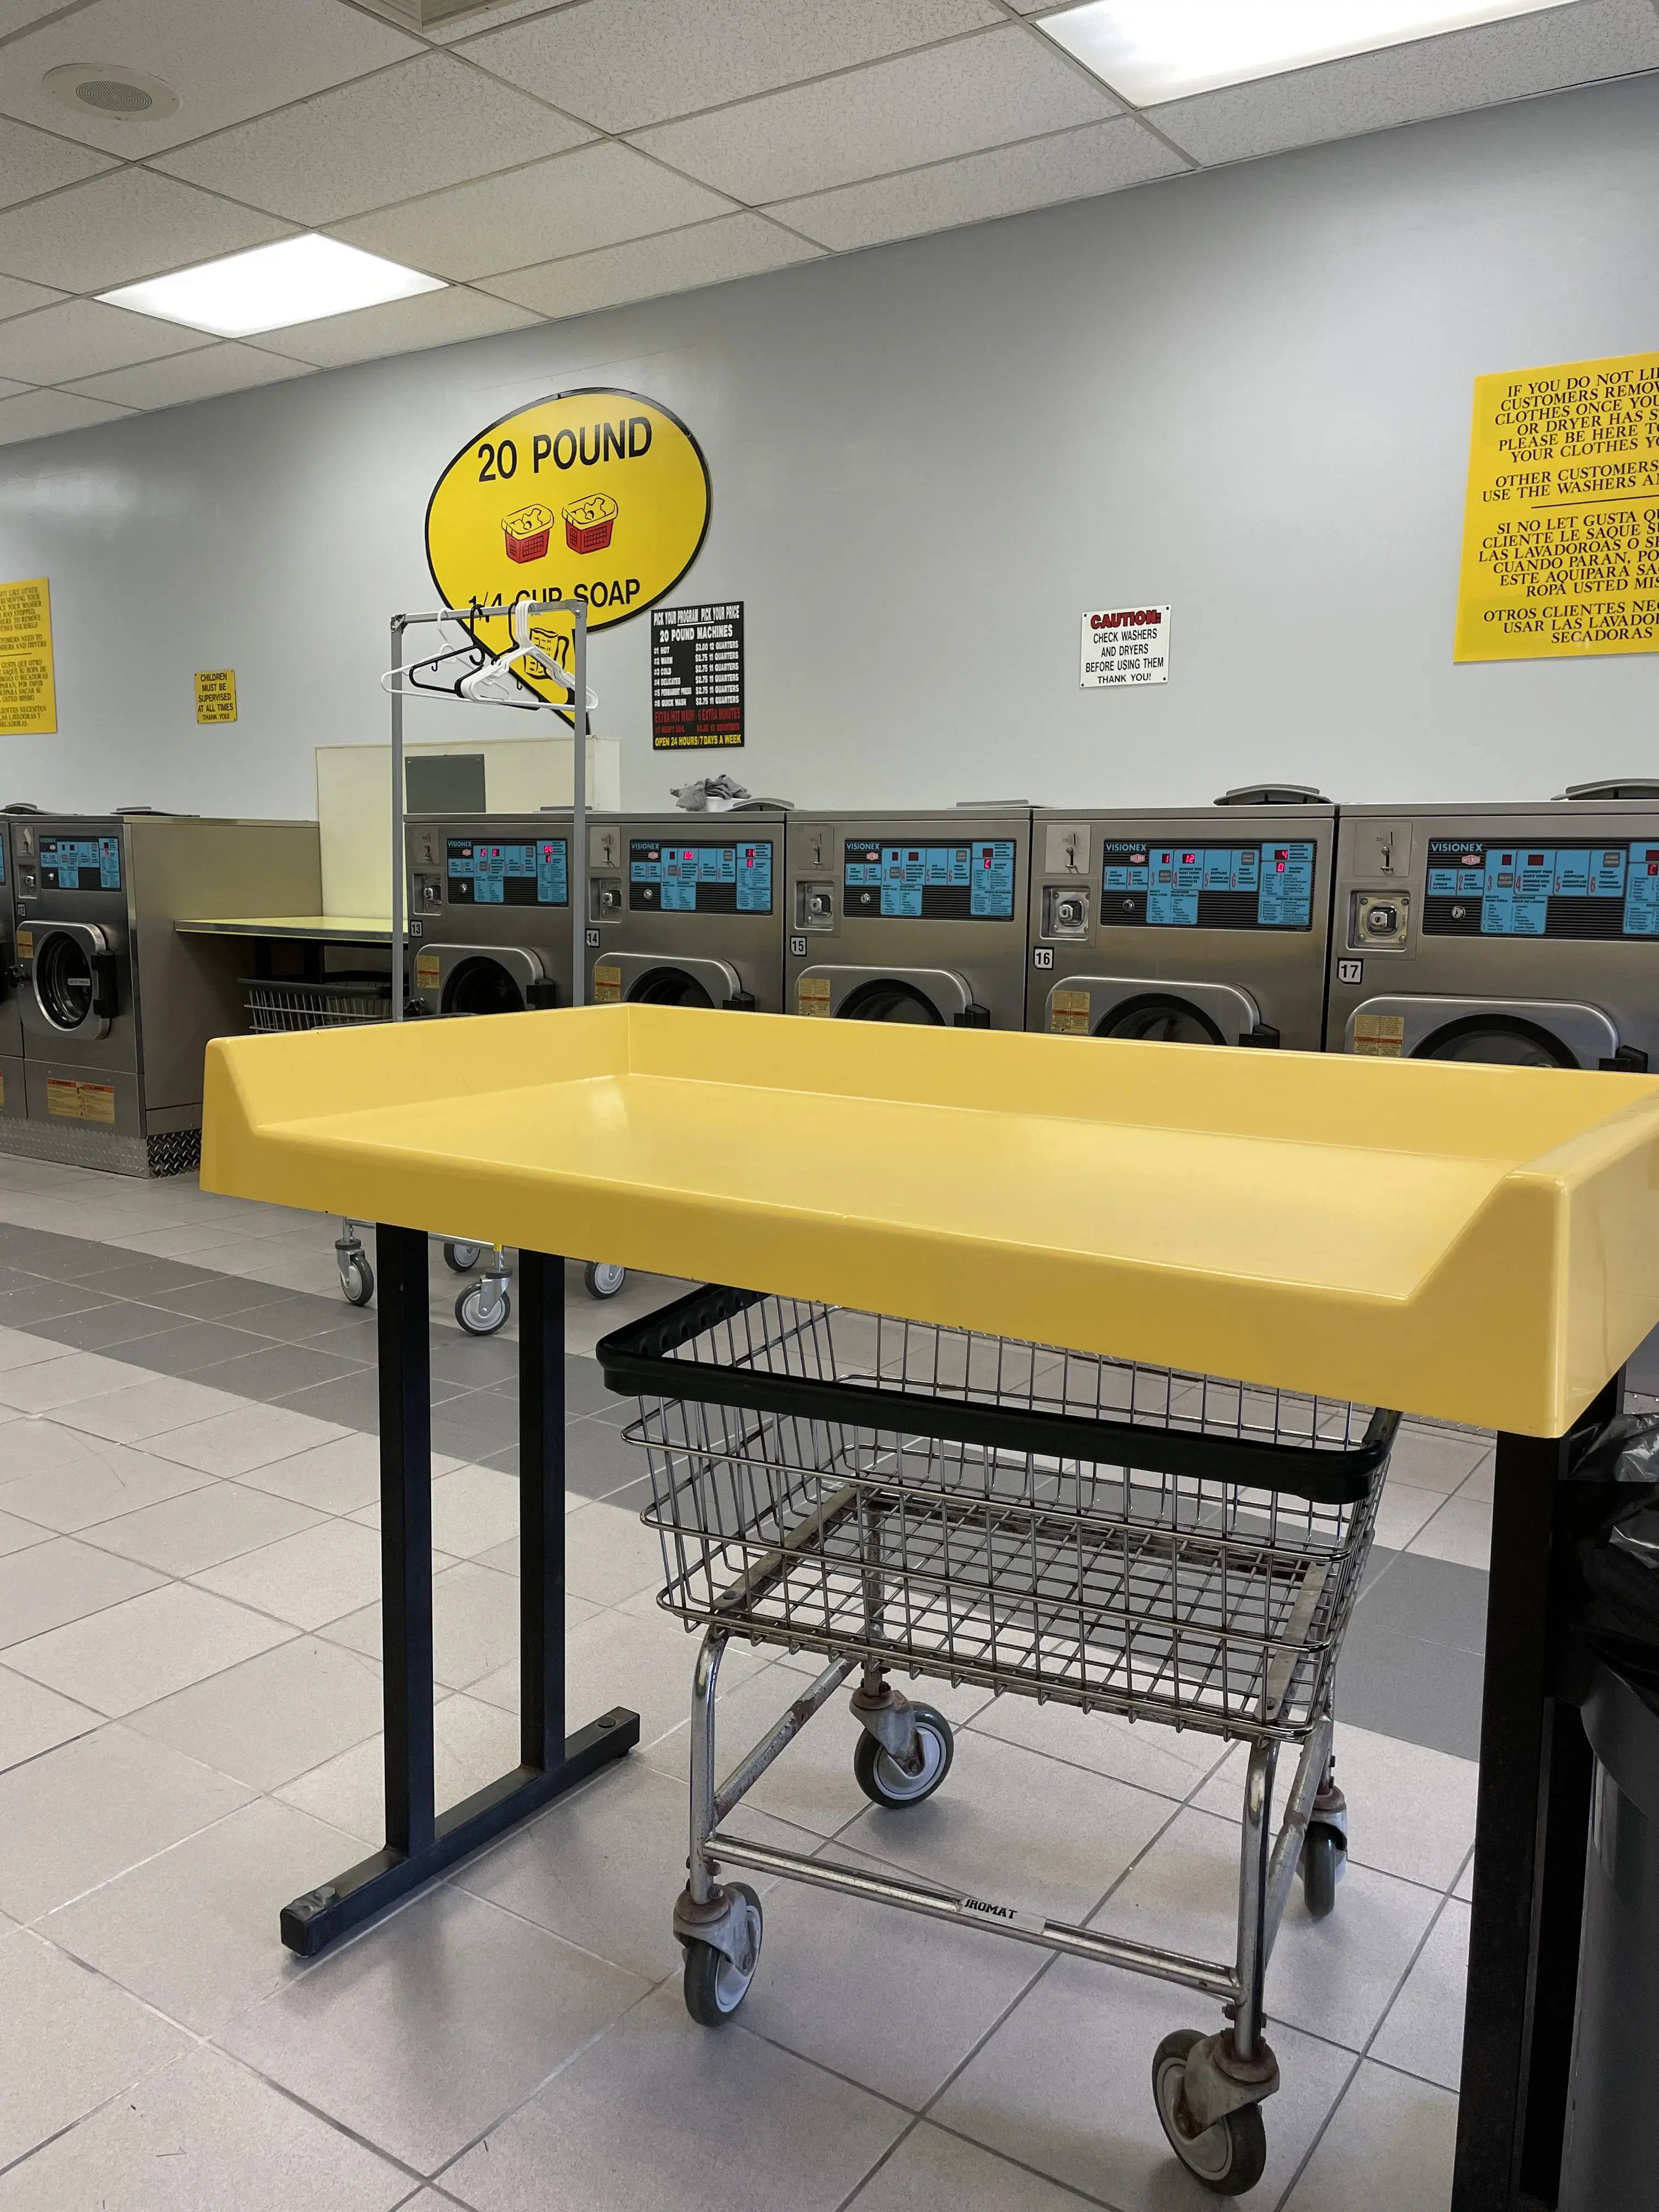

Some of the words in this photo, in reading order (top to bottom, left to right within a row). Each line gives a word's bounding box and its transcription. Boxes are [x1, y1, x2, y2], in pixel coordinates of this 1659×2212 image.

[1508, 385, 1522, 397] IF
[1528, 380, 1560, 394] YOU
[1567, 376, 1590, 390] DO
[1597, 370, 1634, 386] NOT
[1500, 388, 1598, 411] CUSTOMERS
[1495, 405, 1570, 425] CLOTHES
[1576, 399, 1623, 415] ONCE
[1517, 423, 1539, 436] OR
[1545, 415, 1602, 432] DRYER
[1609, 410, 1643, 425] HAS
[1499, 433, 1559, 452] PLEASE
[1565, 430, 1585, 444] BE
[1592, 424, 1639, 441] HERE
[477, 439, 517, 483] 20
[533, 416, 652, 474] POUND
[1511, 448, 1554, 463] YOUR
[1560, 438, 1639, 458] CLOTHES
[1495, 471, 1551, 488] OTHER
[1558, 459, 1658, 481] CUSTOMERS
[1482, 489, 1511, 503] USE
[1516, 484, 1550, 498] THE
[1556, 476, 1636, 494] WASHERS
[1497, 522, 1510, 534] SI
[1517, 520, 1541, 533] NO
[1547, 516, 1578, 530] LET
[1583, 511, 1637, 527] GUSTA
[1482, 532, 1554, 549] CLIENTE
[1560, 529, 1580, 543] LE
[1585, 524, 1641, 540] SAQUE
[1479, 549, 1508, 562] LAS
[1515, 539, 1621, 560] LAVADOROAS
[1627, 537, 1639, 549] O
[1493, 557, 1563, 574] CUANDO
[1569, 551, 1630, 567] PARAN,
[1500, 572, 1539, 586] ESTE
[1546, 565, 1629, 584] AQUIPARA
[1637, 563, 1659, 576] SA
[574, 578, 641, 607] SOAP
[1526, 584, 1567, 597] ROPA
[1573, 579, 1628, 594] USTED
[654, 612, 664, 626] PICK
[665, 611, 676, 625] YOUR
[678, 609, 698, 623] PROGRAM
[701, 607, 712, 622] PICK
[713, 606, 725, 620] YOUR
[726, 605, 740, 619] PRICE
[1091, 610, 1161, 629] CAUTION:
[1483, 608, 1537, 622] OTROS
[1542, 602, 1626, 618] CLIENTES
[659, 630, 669, 642] 20
[671, 628, 695, 641] POUND
[697, 624, 733, 639] MACHINES
[1503, 620, 1544, 634] USAR
[1551, 618, 1582, 630] LAS
[1093, 631, 1118, 644] CHECK
[1122, 628, 1157, 641] WASHERS
[1551, 627, 1652, 644] SECADORAS
[715, 640, 738, 650] QUARTERS
[1101, 647, 1116, 657] AND
[1119, 644, 1148, 656] DRYERS
[695, 653, 708, 662] $2.75
[709, 653, 714, 661] 11
[714, 651, 738, 661] QUARTERS
[695, 664, 708, 673] $2.75
[714, 662, 739, 672] QUARTERS
[1086, 661, 1114, 673] BEFORE
[1118, 659, 1140, 670] USING
[1143, 657, 1164, 668] THEM
[201, 673, 227, 681] CHILDREN
[695, 675, 708, 684] $2.75
[715, 674, 739, 682] QUARTERS
[1097, 675, 1126, 684] THANK
[1131, 673, 1151, 681] YOU!
[202, 684, 217, 692] MUST
[695, 686, 708, 695] $2.75
[715, 685, 739, 693] QUARTERS
[199, 693, 231, 702] SUPERVISED
[696, 697, 708, 706] $2.75
[715, 696, 739, 704] QUARTERS
[217, 703, 233, 711] TIMES
[655, 737, 669, 746] OPEN
[671, 737, 678, 746] 24
[703, 736, 718, 744] DAYS
[719, 735, 723, 744] A
[724, 735, 741, 743] WEEK
[1431, 843, 1483, 852] VISIONEX
[1186, 854, 1195, 863] 12
[412, 924, 420, 934] 13
[588, 933, 597, 943] 14
[792, 941, 804, 952] 15
[1036, 952, 1050, 965] 16
[1341, 964, 1358, 978] 17
